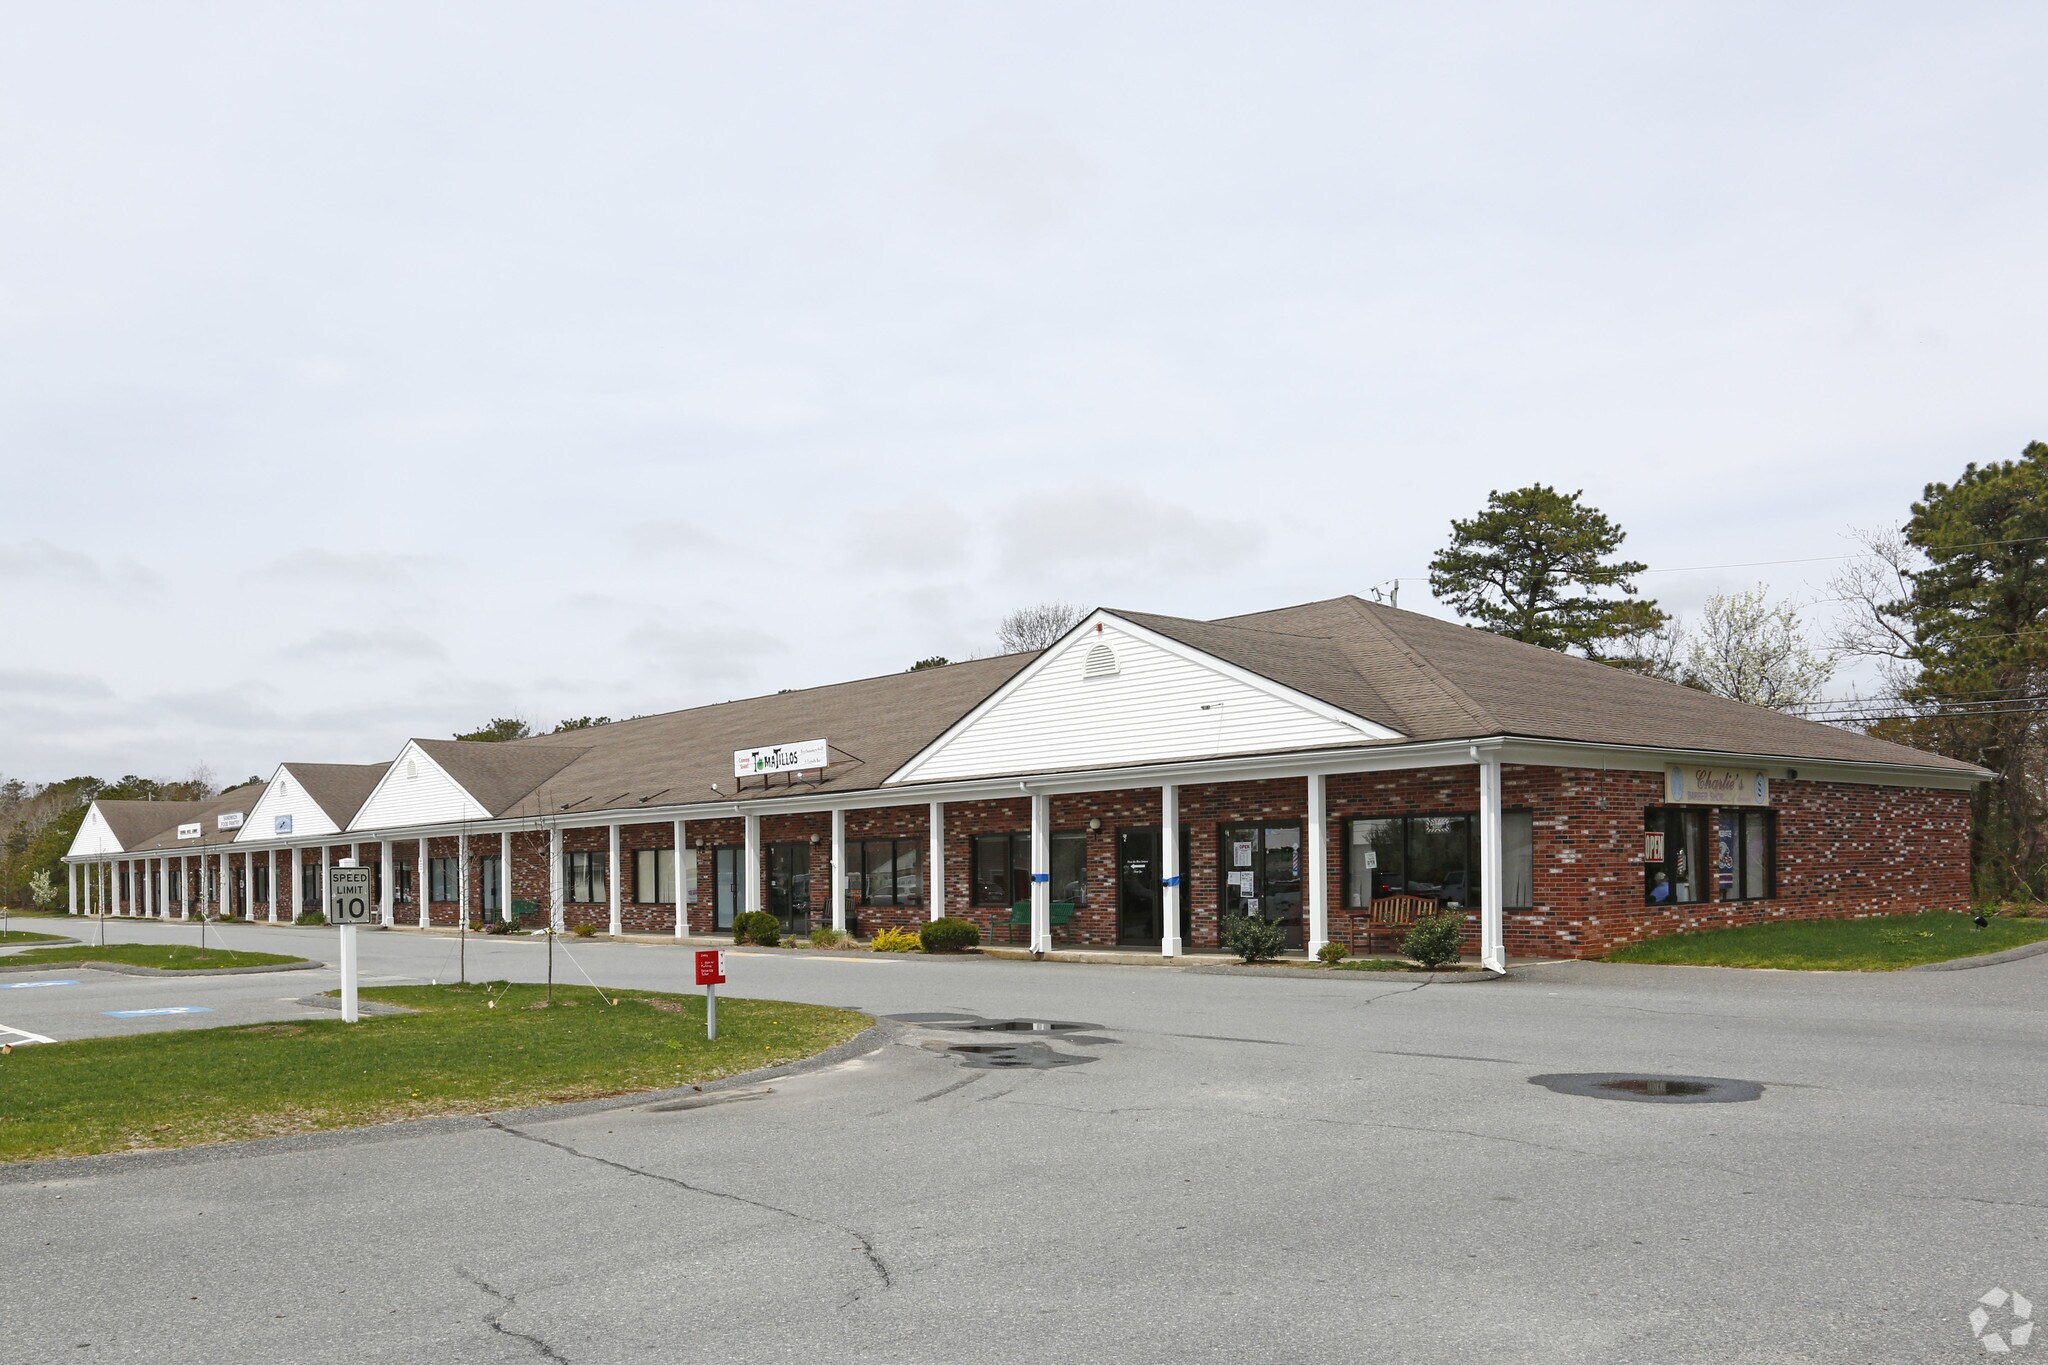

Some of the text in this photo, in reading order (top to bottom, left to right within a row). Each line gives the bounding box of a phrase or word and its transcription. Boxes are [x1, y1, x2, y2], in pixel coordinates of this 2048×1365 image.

[1696, 769, 1744, 790] Charlie's
[1645, 835, 1664, 860] OPEN
[333, 874, 367, 882] SPEED
[337, 886, 363, 894] LIMIT
[336, 898, 365, 918] 10
